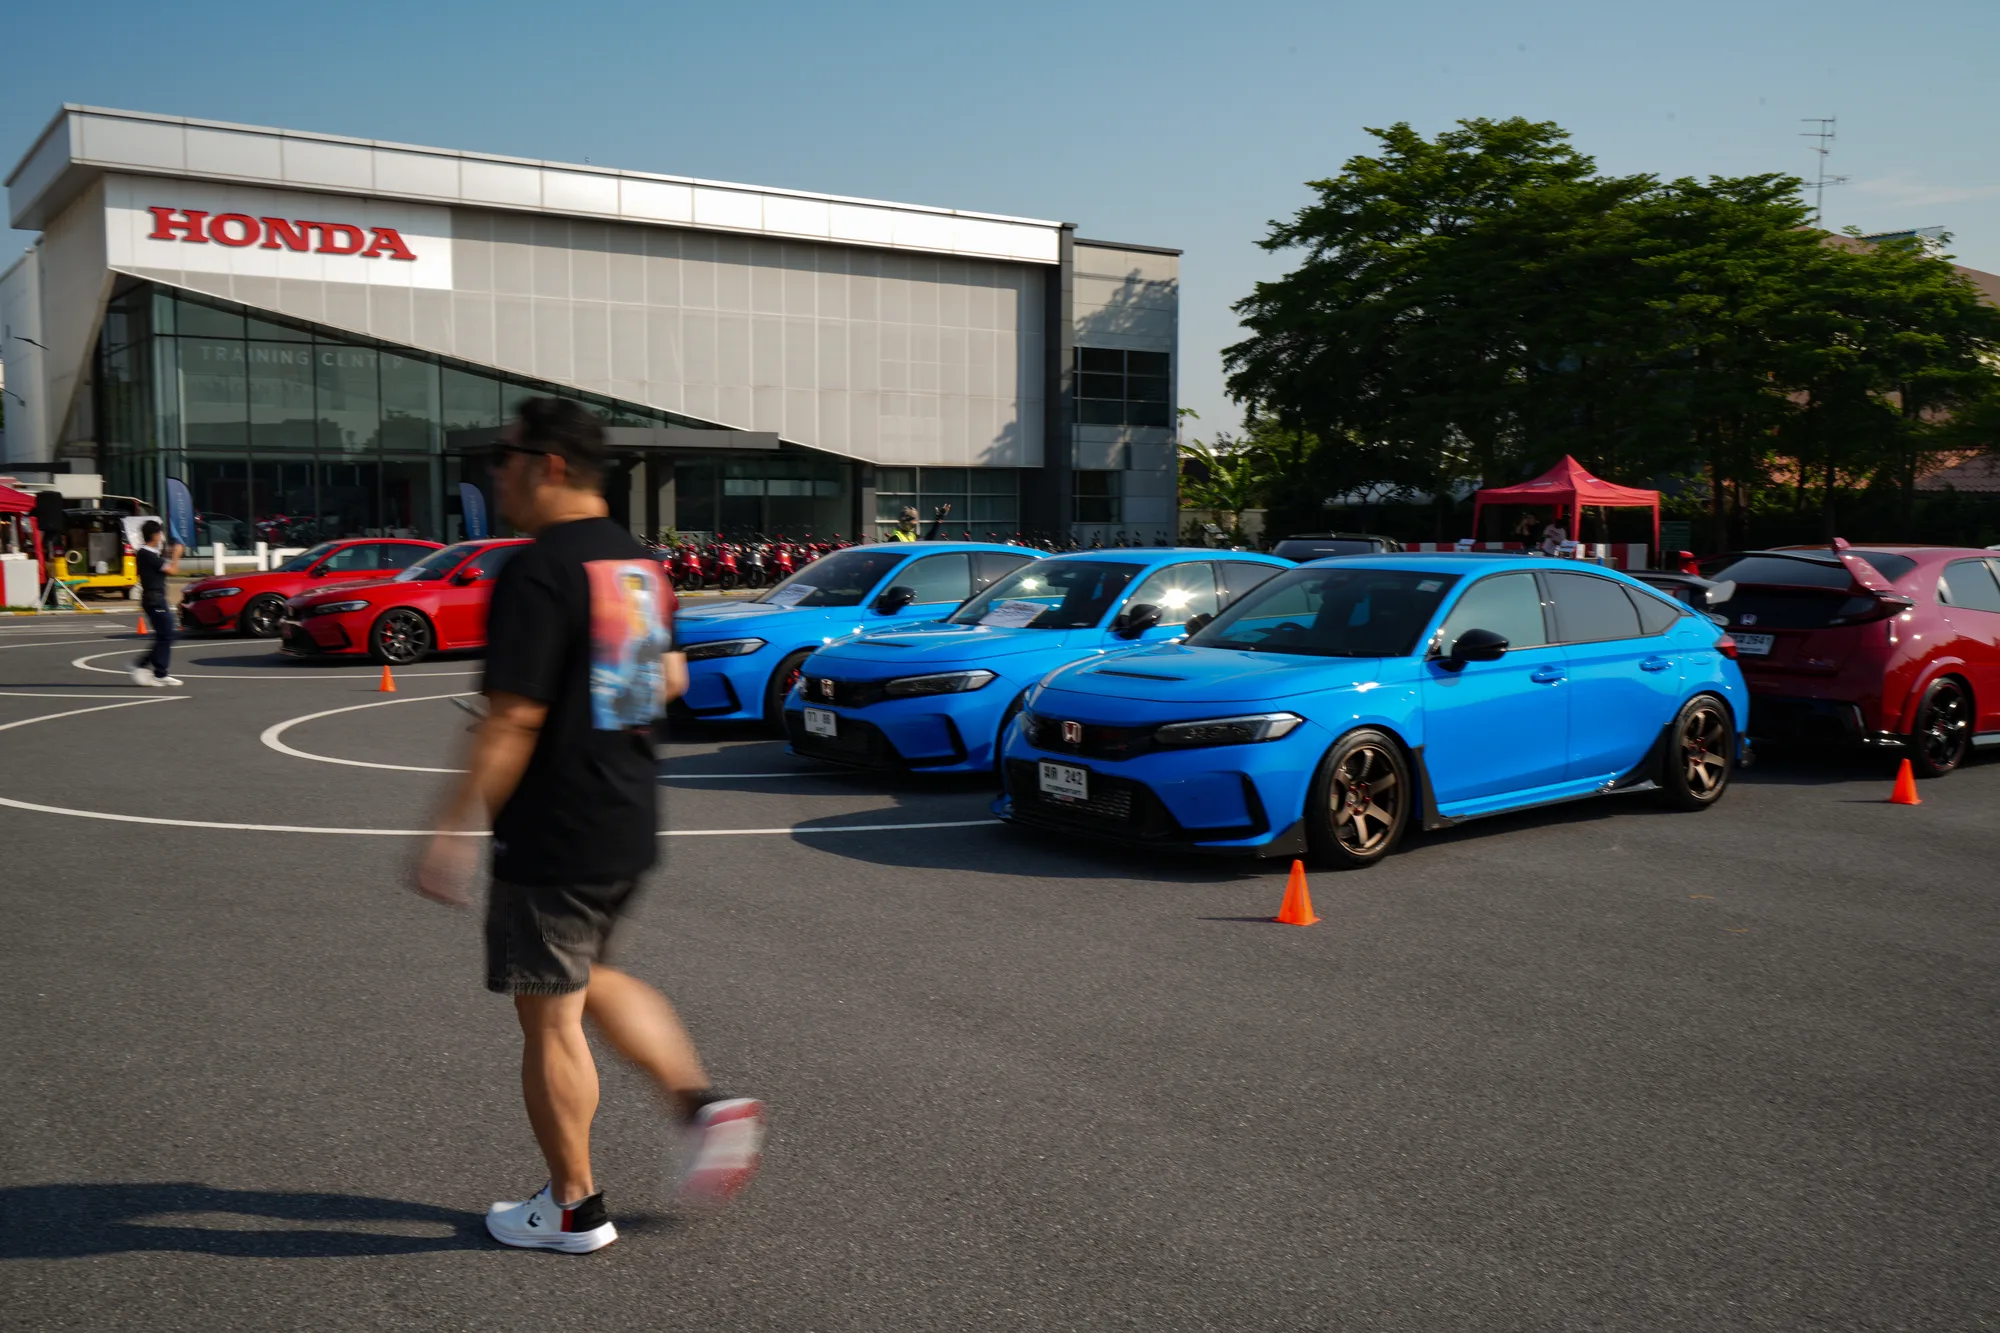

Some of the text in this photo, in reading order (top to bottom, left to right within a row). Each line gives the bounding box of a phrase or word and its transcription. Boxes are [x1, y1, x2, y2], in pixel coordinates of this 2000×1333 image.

[148, 206, 417, 260] HONDA
[200, 345, 310, 366] TRAINING
[1064, 769, 1083, 786] 242
